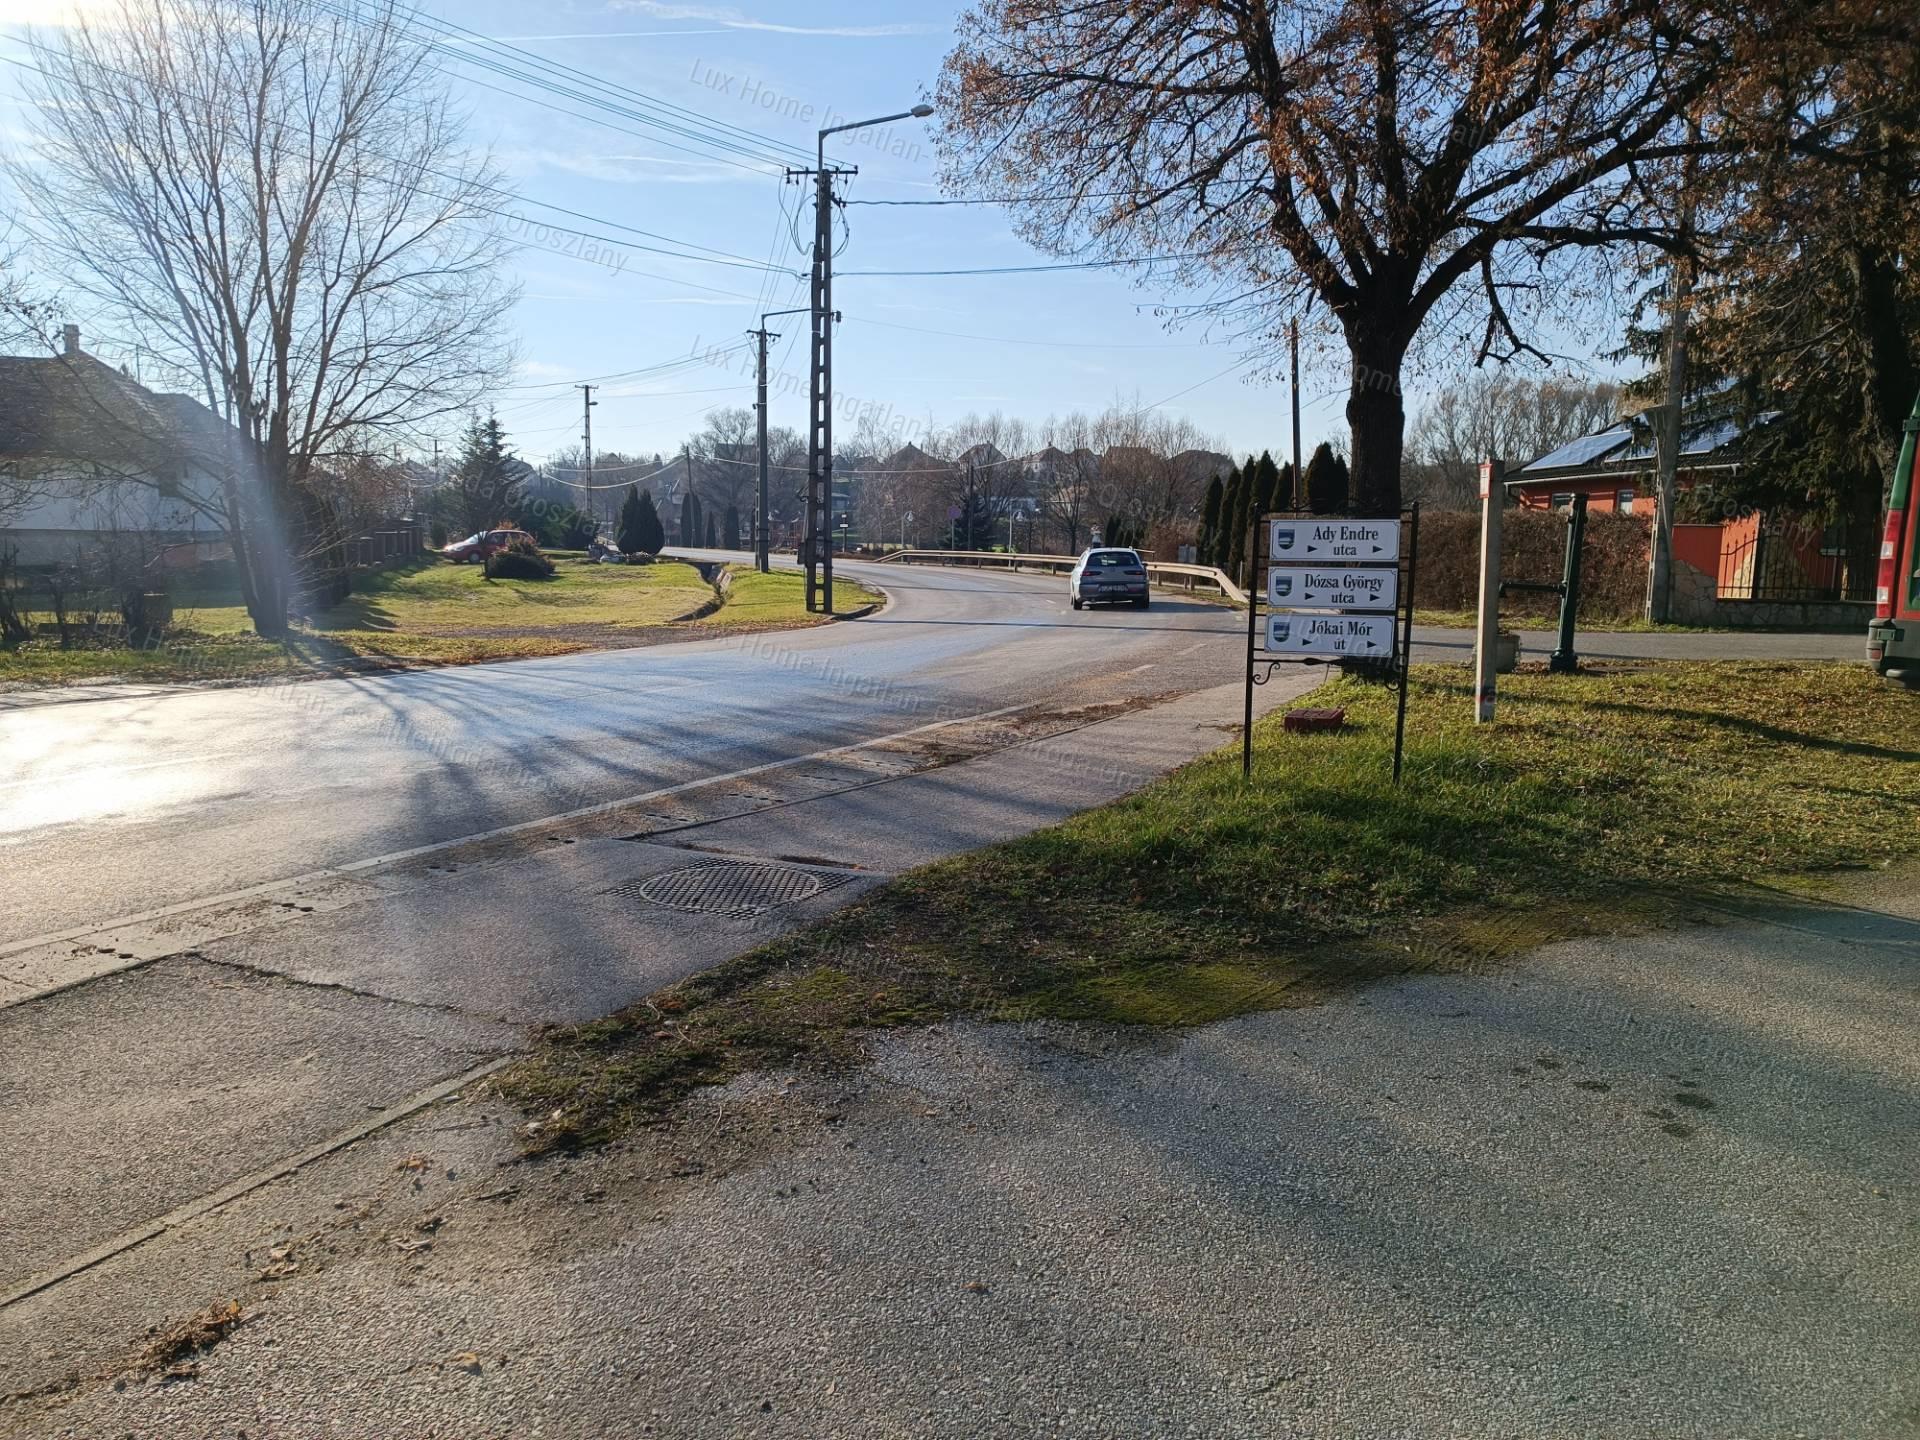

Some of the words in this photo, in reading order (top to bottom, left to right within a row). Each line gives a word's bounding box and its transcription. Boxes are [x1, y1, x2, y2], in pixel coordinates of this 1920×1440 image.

[1312, 526, 1337, 543] Ady
[1340, 526, 1379, 541] Endre
[1333, 545, 1357, 556] utca
[1304, 573, 1339, 589] Dózsa
[1343, 574, 1385, 592] György
[1331, 593, 1355, 604] utca
[1308, 620, 1344, 635] Jókai
[1347, 621, 1373, 636] Mór
[1334, 638, 1346, 650] út
